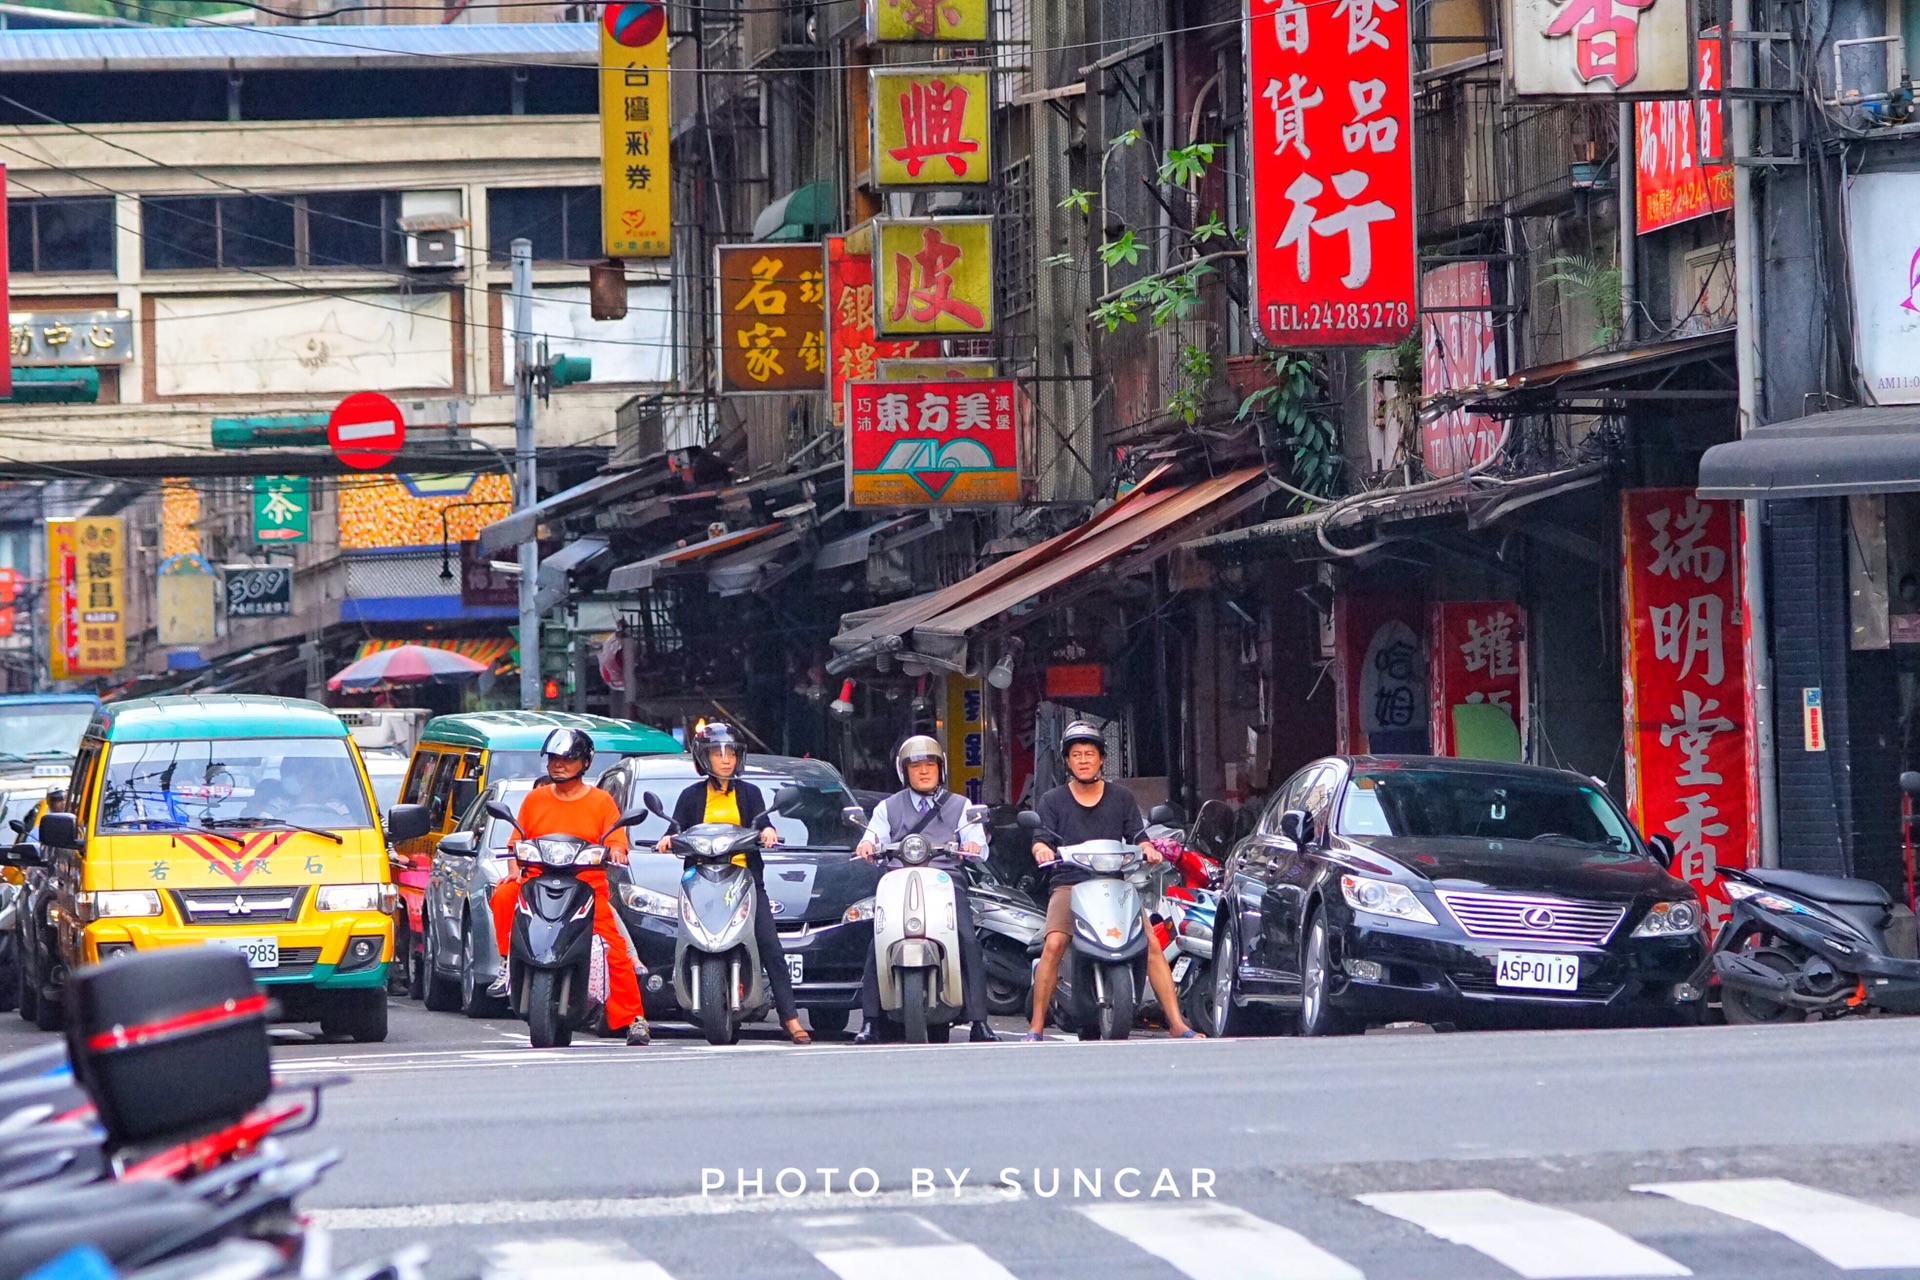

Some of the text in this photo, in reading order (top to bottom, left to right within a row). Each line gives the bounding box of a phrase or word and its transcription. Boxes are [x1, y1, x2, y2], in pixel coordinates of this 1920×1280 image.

[624, 61, 651, 190] 台灣彩券
[887, 78, 980, 177] 興
[1262, 0, 1325, 160] 百貨
[891, 226, 985, 331] 皮
[1274, 169, 1396, 290] 行
[735, 255, 788, 383] 名家
[1267, 301, 1409, 331] TEL:24283278
[876, 391, 992, 433] 東方美
[995, 395, 1011, 431] 漢堡
[226, 569, 285, 604] 369
[304, 855, 324, 875] 石
